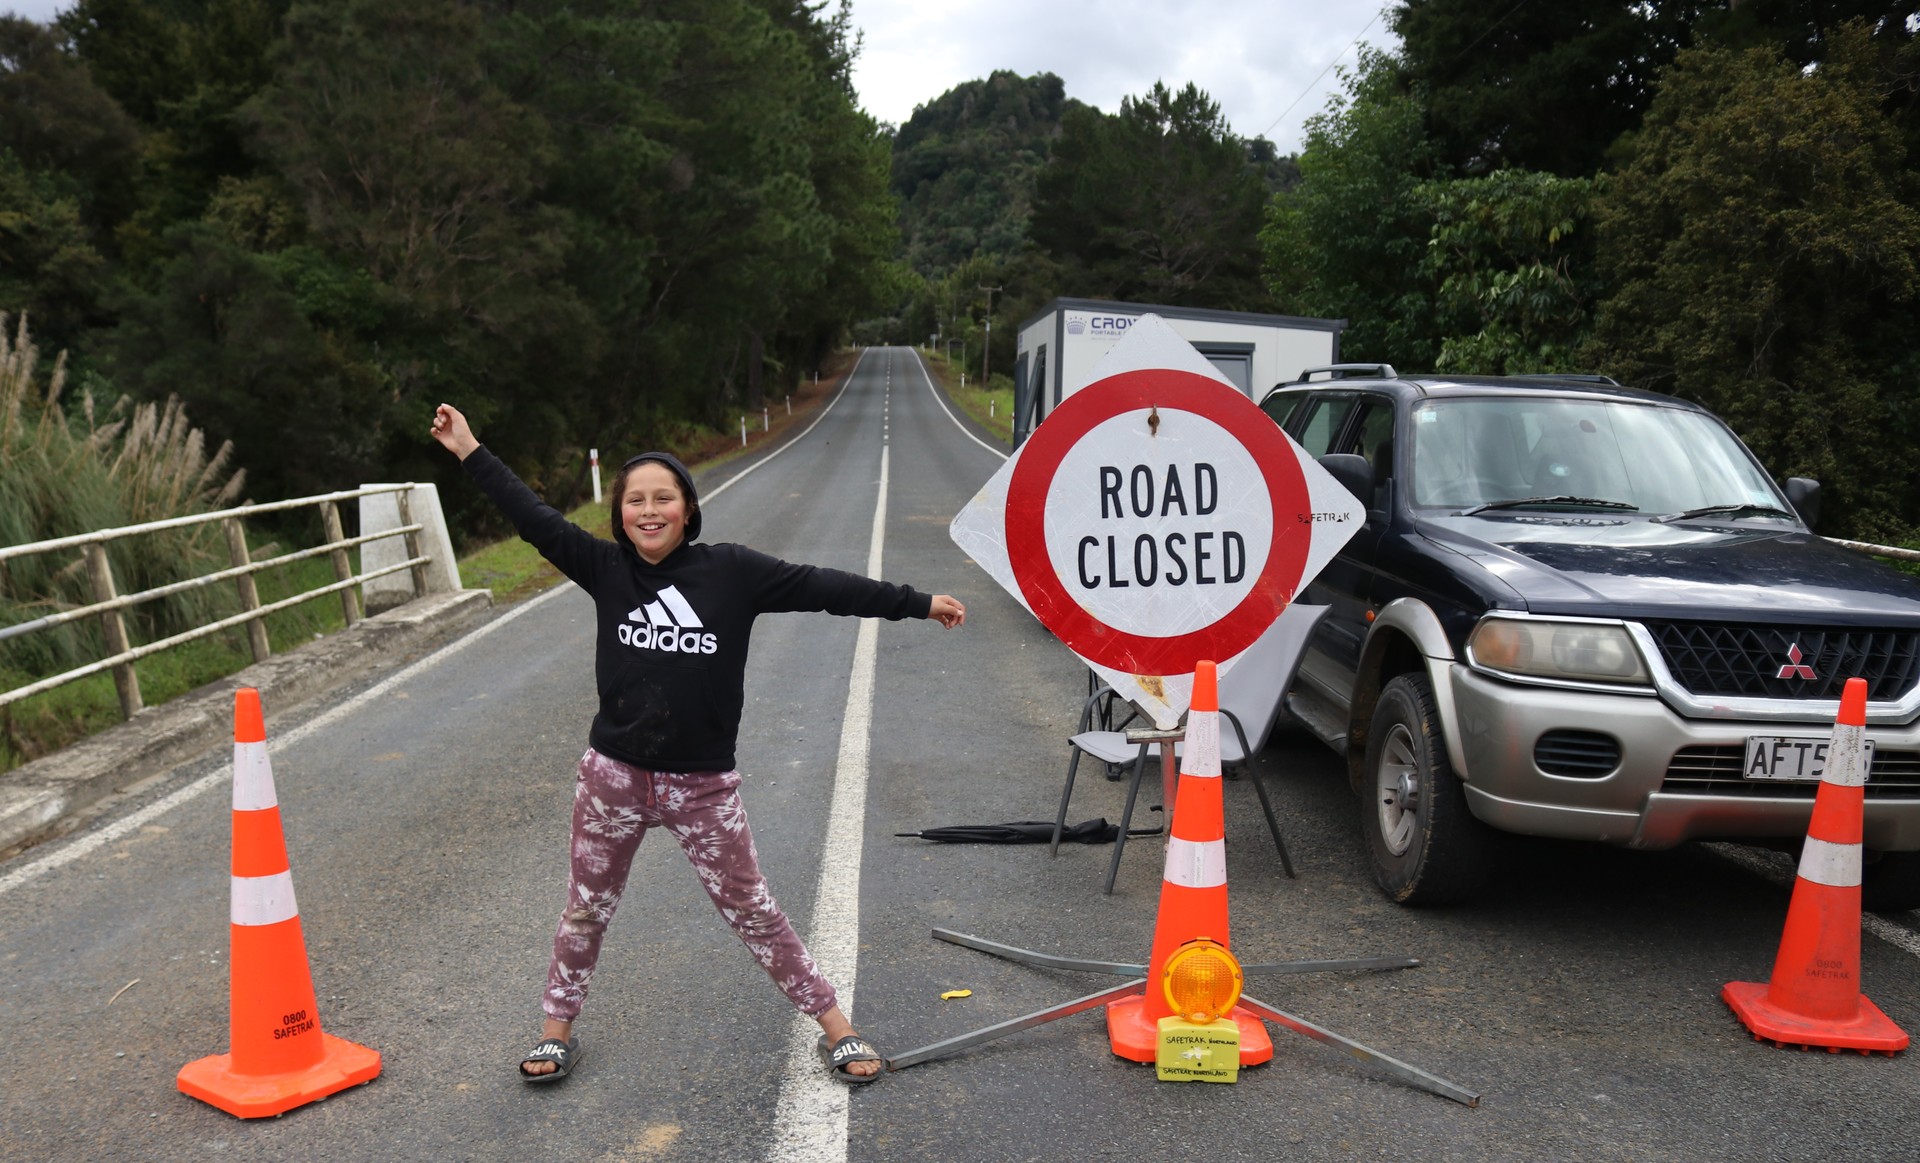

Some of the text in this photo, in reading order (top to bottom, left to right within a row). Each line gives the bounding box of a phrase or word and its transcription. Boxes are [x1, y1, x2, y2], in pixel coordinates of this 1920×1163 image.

[1099, 463, 1218, 519] ROAD
[1297, 512, 1350, 523] SAFETRAK
[1077, 531, 1246, 590] CLOSED
[618, 623, 718, 655] adidas
[1749, 742, 1870, 776] AFT5
[1804, 968, 1850, 980] SAFETRAK
[1816, 959, 1843, 969] 0800
[282, 1009, 307, 1026] 0800
[273, 1017, 315, 1040] SAFETRAK
[1166, 1036, 1207, 1044] SAFETRAK
